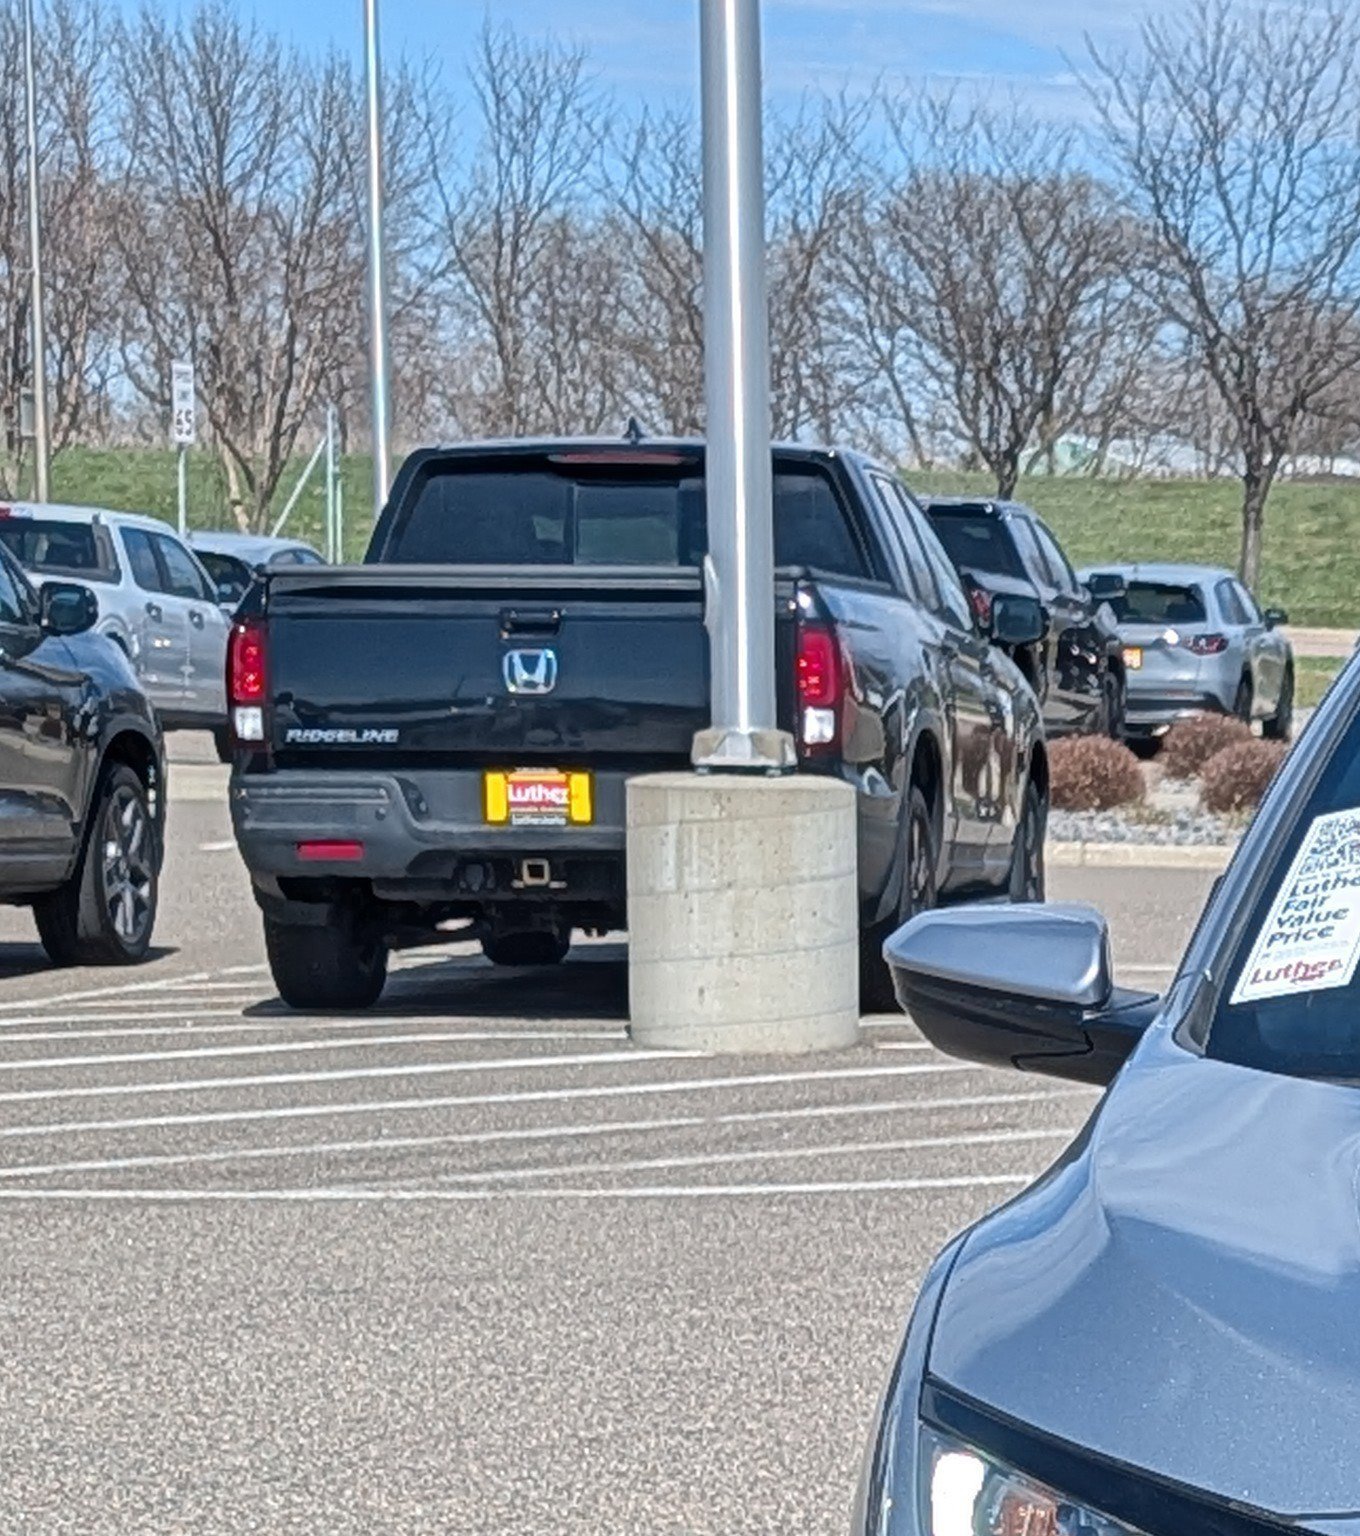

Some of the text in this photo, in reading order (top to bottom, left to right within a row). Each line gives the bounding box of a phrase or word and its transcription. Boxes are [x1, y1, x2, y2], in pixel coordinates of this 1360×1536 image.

[285, 728, 399, 743] RIDGELINE
[507, 784, 569, 804] Luther
[1281, 894, 1331, 915] Fair
[1275, 907, 1350, 929] Value
[1266, 925, 1335, 949] Price
[1250, 959, 1340, 986] Luther
